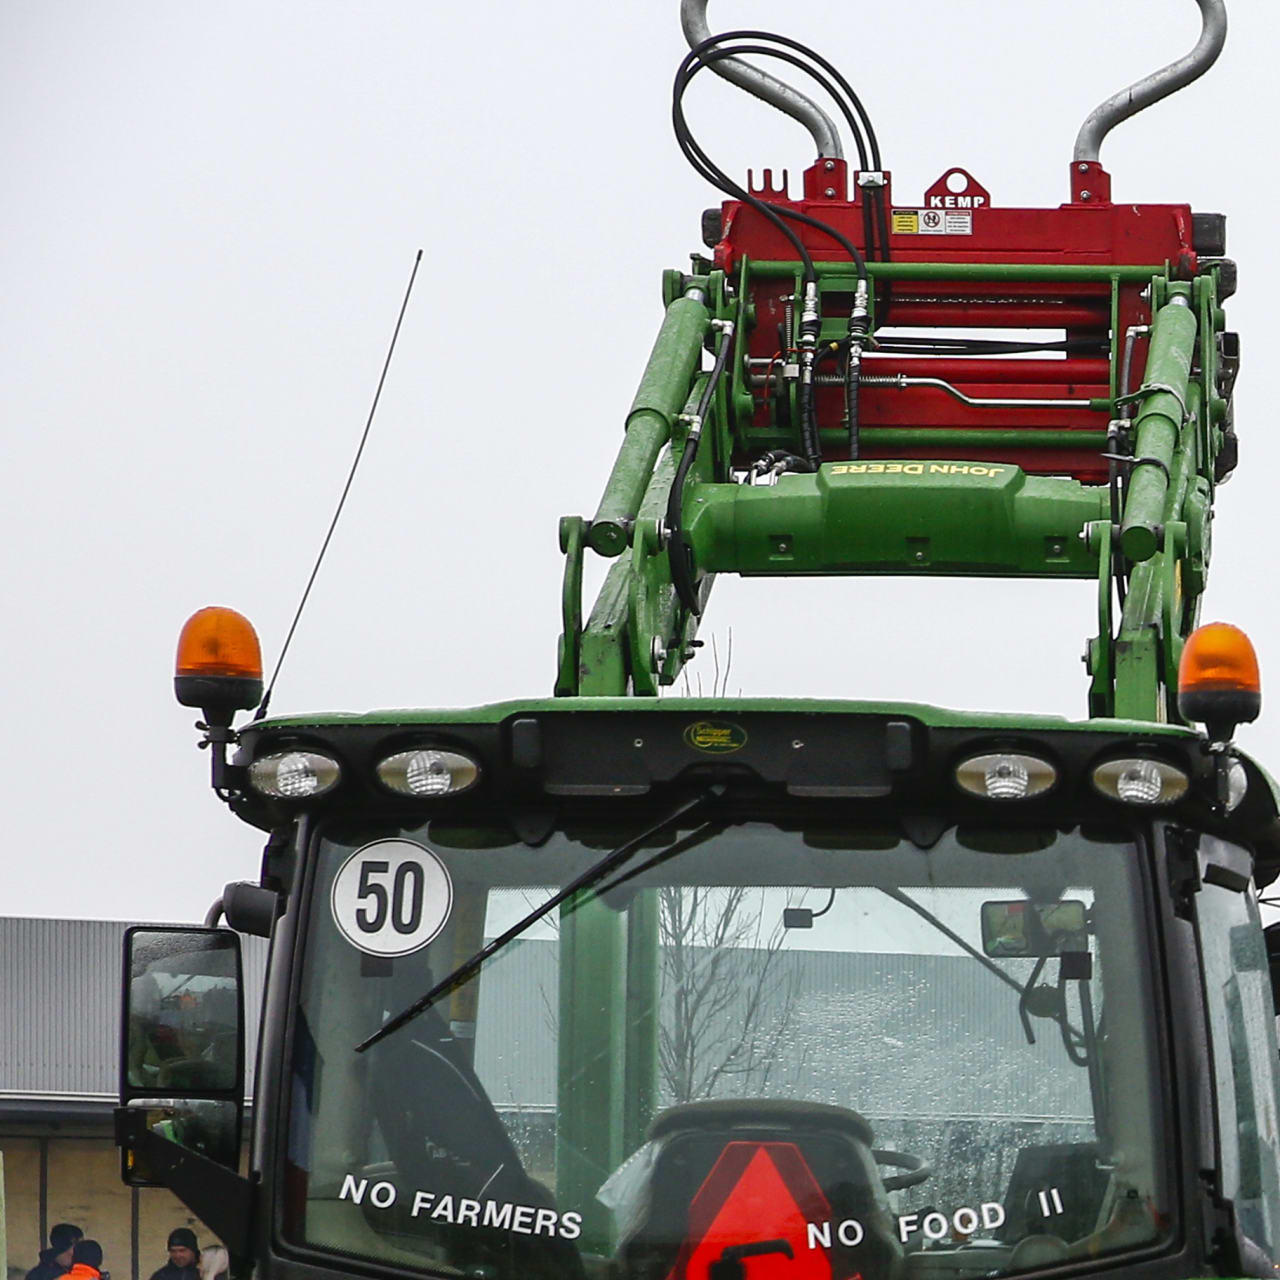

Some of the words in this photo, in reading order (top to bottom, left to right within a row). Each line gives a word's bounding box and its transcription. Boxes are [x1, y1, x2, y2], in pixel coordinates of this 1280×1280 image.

[930, 195, 985, 208] KEMP
[831, 463, 924, 475] DEERE
[930, 464, 1005, 478] JOHN
[356, 860, 425, 935] 50
[338, 1173, 397, 1209] NO
[410, 1190, 583, 1241] FARMERS
[806, 1218, 864, 1250] NO
[898, 1201, 1006, 1244] FOOD
